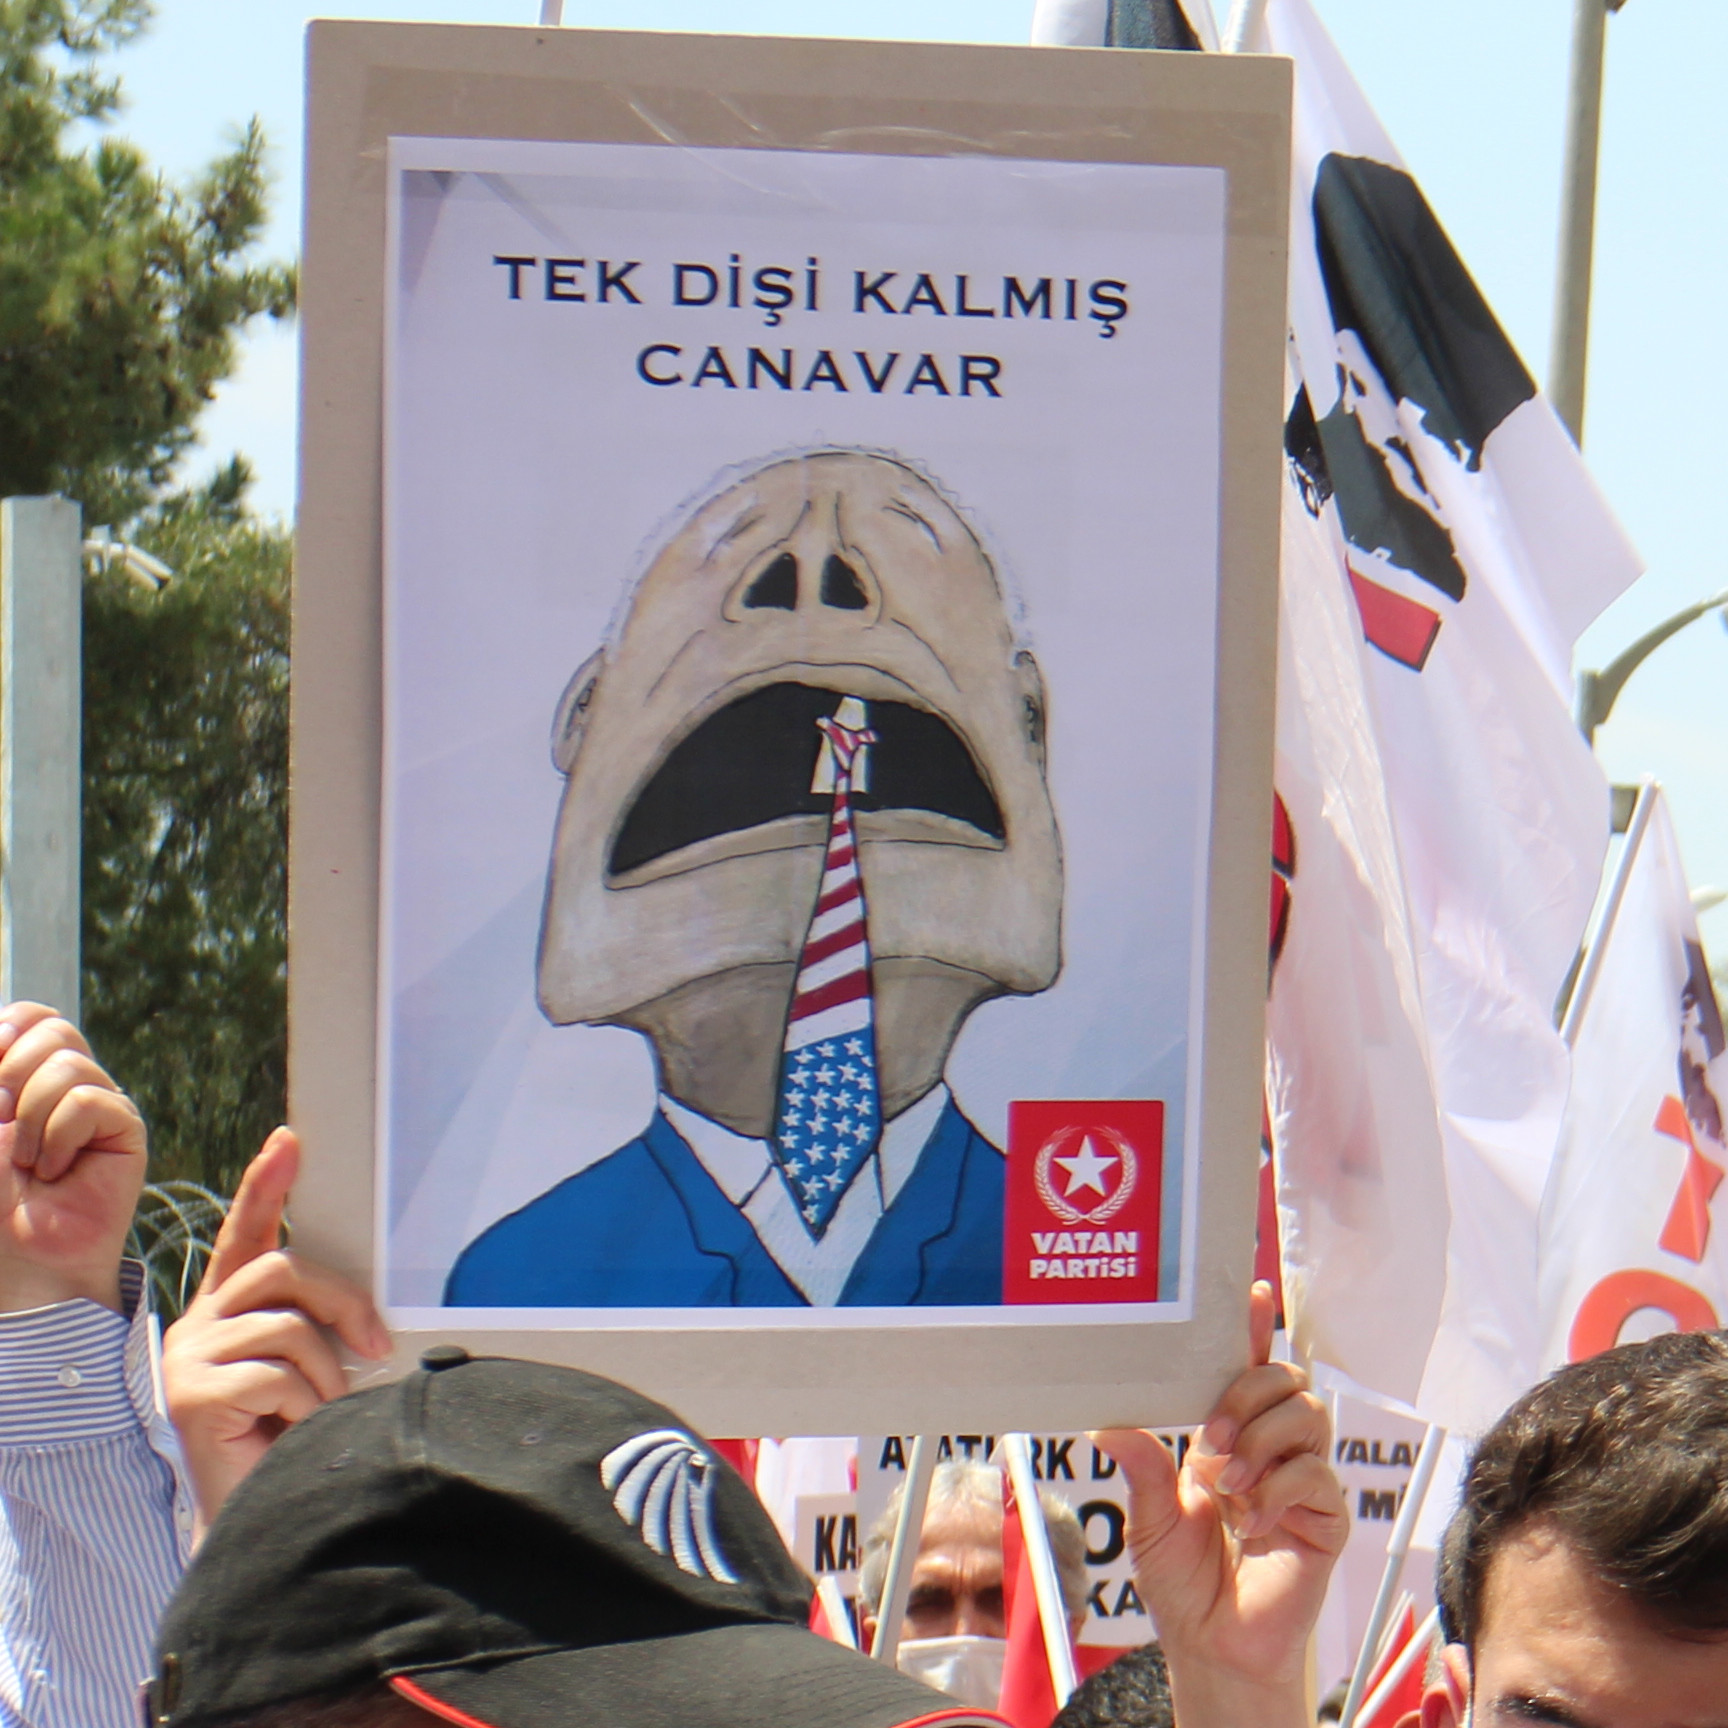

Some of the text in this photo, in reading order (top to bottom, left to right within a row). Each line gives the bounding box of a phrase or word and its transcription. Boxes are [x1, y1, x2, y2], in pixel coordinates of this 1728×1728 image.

[492, 253, 1129, 339] TEK DİŞİ KALMIŞ
[636, 344, 1003, 399] CANAVAR
[1030, 1231, 1139, 1255] VATAN
